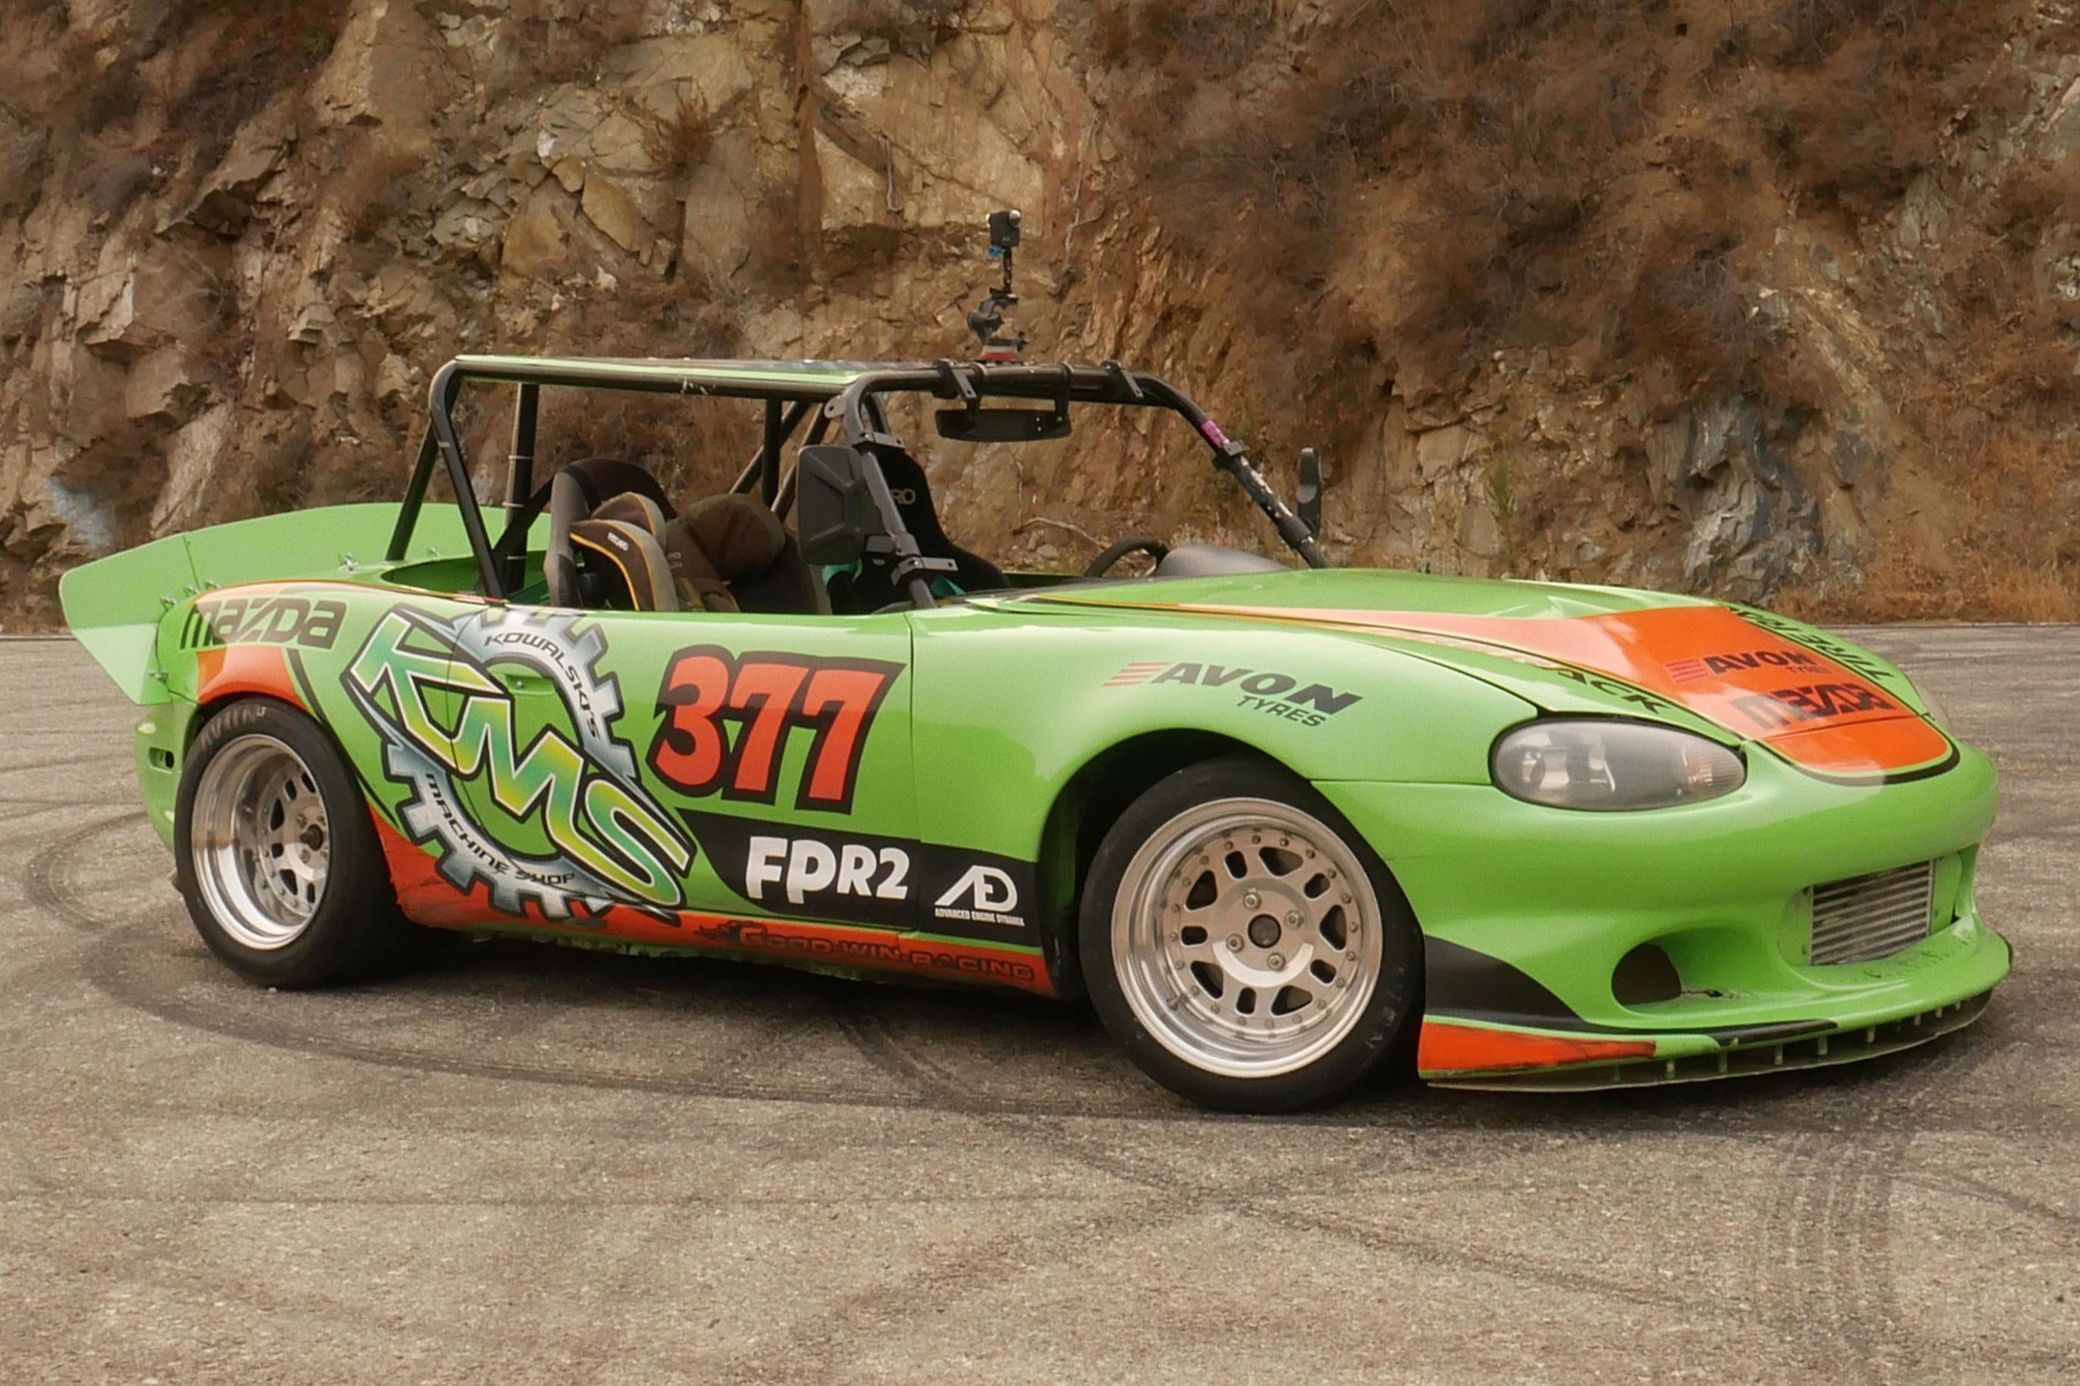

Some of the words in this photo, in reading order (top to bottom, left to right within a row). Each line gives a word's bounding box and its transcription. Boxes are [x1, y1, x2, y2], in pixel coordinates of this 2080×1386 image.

[1151, 662, 1364, 715] AVON
[1703, 651, 1817, 675] AVON
[650, 648, 900, 810] 377
[1236, 695, 1327, 728] TYRES
[344, 609, 695, 909] KMS
[424, 773, 511, 876] MACHINE
[514, 869, 576, 885] SHOP
[745, 836, 911, 904] FPR2
